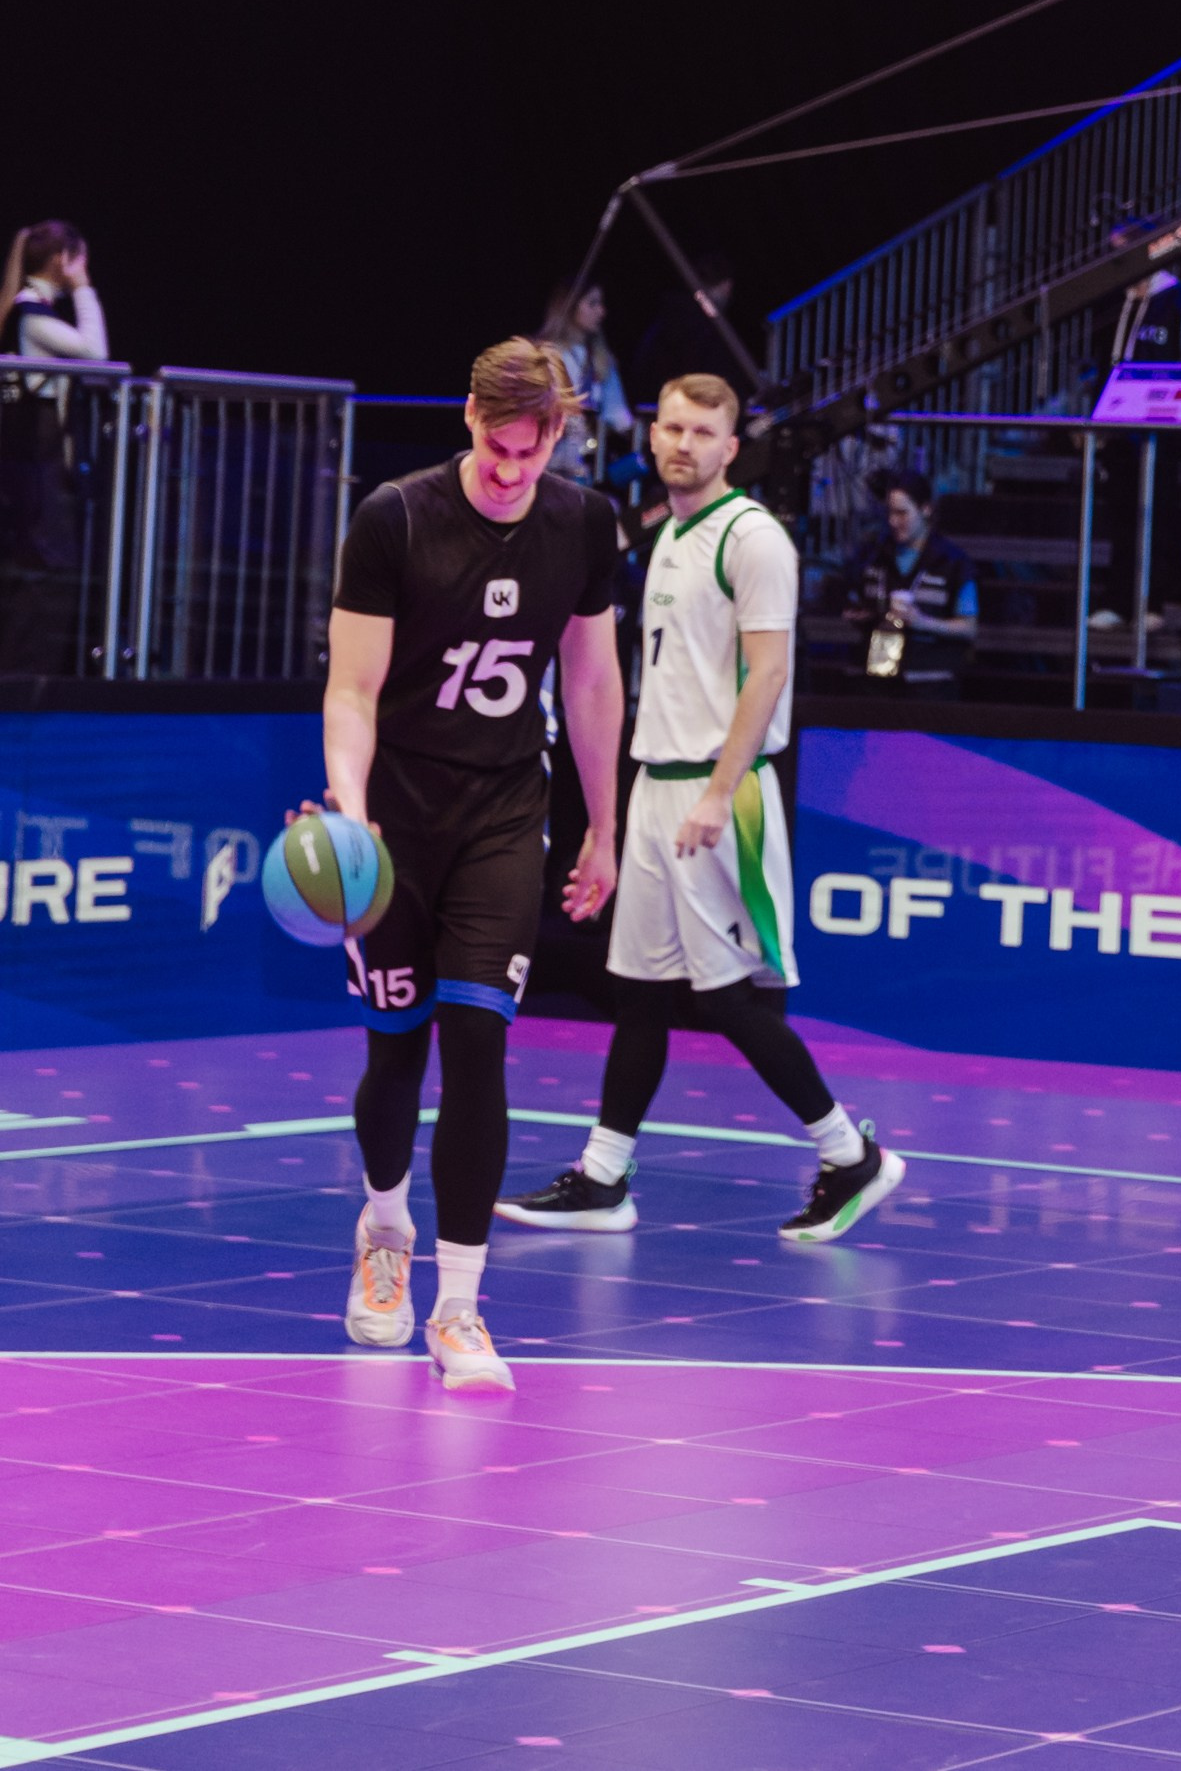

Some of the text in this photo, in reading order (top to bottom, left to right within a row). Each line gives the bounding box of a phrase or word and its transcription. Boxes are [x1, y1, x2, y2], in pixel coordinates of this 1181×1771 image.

[435, 638, 535, 718] 15
[0, 856, 134, 926] RE
[809, 871, 953, 940] OF
[368, 967, 416, 1009] 15
